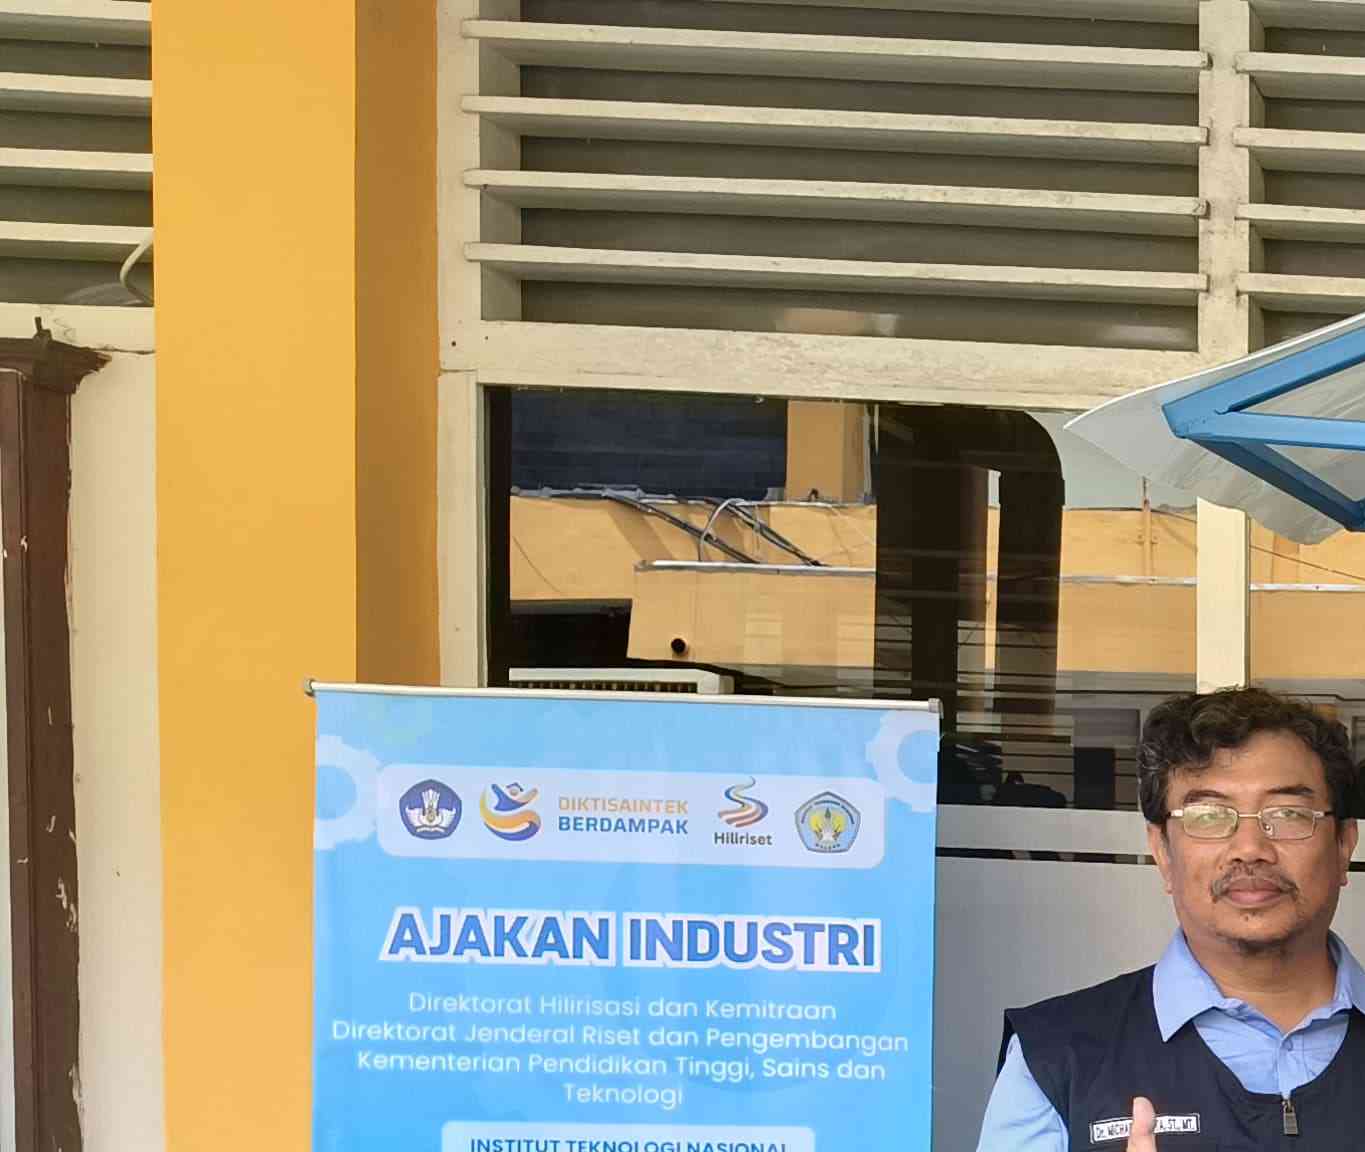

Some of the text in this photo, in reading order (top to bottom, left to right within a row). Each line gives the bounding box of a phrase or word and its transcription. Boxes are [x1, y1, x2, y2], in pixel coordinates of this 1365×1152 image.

[558, 797, 688, 816] DIKTISAINTEK
[558, 816, 688, 835] BERDAMPAK
[714, 831, 772, 847] Hiliriset
[385, 911, 878, 969] AJAKAN INDUSTRI
[409, 993, 836, 1020] Direktorat Hilirisasi dan Kemitraan
[332, 1021, 909, 1054] Direktorat Jenderal Riset dan Pengembangan
[358, 1052, 885, 1081] Kementerian Pendidikan Tinggi, Sains dan
[564, 1083, 684, 1110] Teknologi
